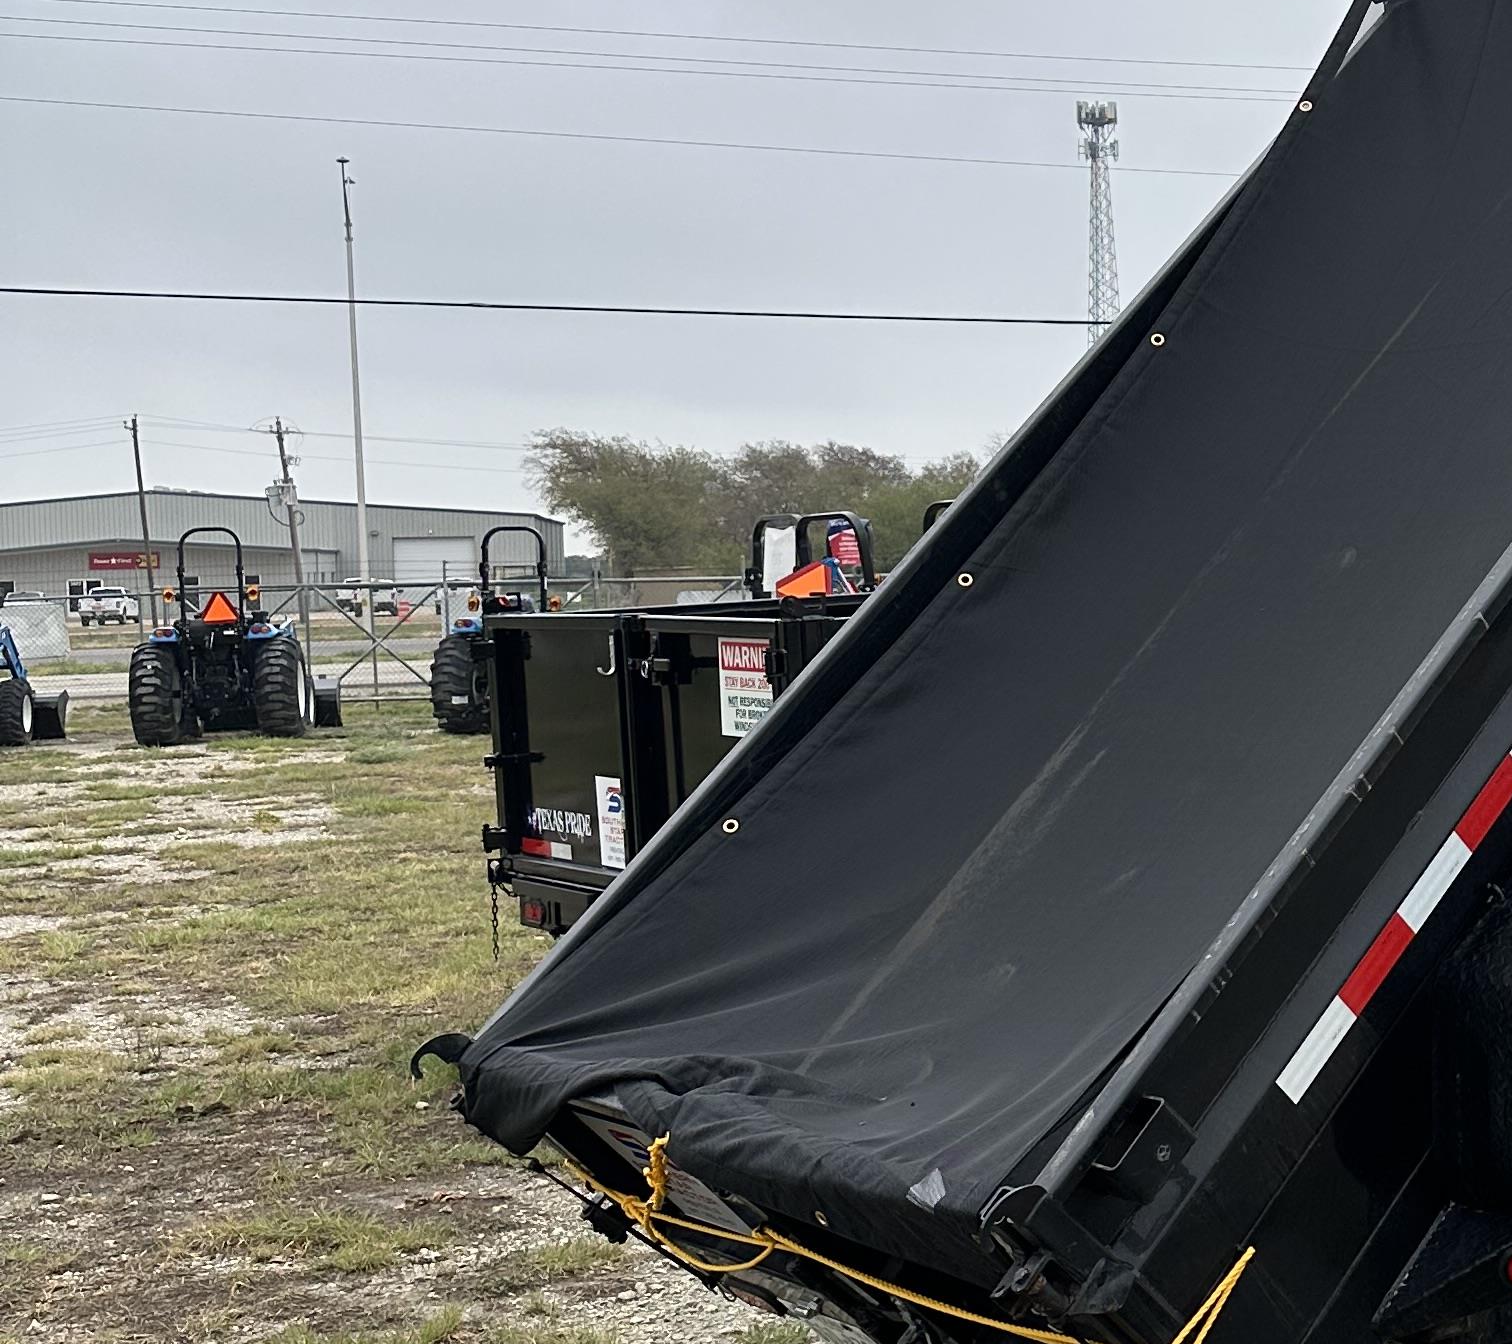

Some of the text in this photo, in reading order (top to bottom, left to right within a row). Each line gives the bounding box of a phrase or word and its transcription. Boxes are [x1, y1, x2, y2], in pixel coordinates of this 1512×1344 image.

[722, 645, 765, 669] WARNI
[740, 677, 755, 688] BACK
[535, 808, 592, 838] TEXAS PRIDE
